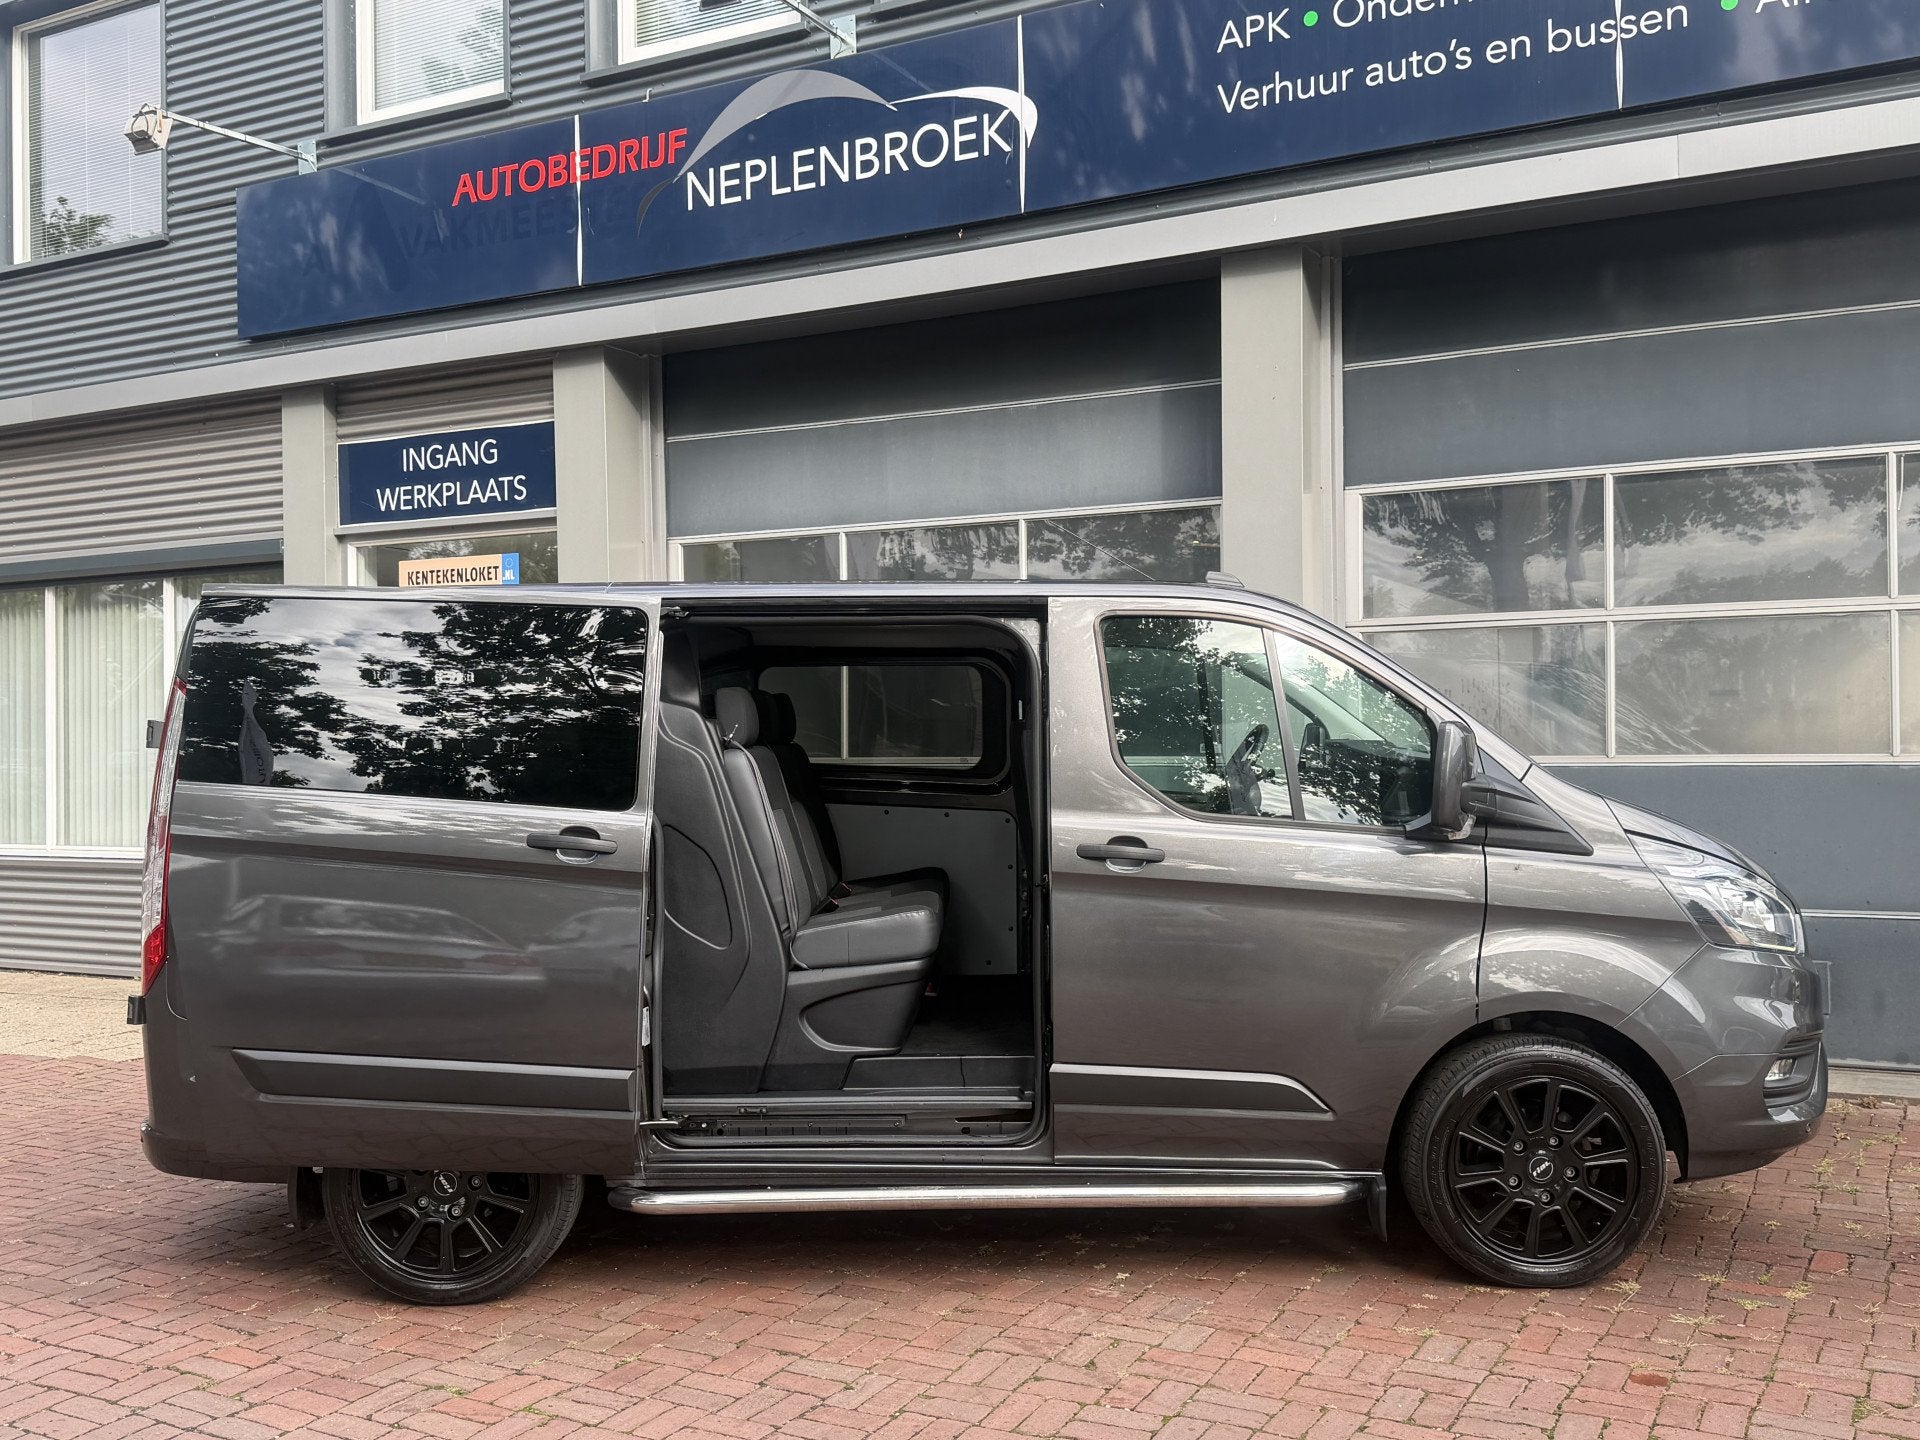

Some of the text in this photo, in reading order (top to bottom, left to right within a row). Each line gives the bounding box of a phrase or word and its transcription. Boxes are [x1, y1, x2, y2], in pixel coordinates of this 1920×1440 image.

[1217, 8, 1290, 53] APK
[1217, 4, 1688, 113] Verhuur auto’s en bussen
[452, 128, 687, 206] AUTOBEDRIJF
[686, 109, 1012, 211] NEPLENBROEK
[402, 439, 498, 472] INGANG
[376, 475, 527, 512] WERKPLAATS
[407, 566, 500, 585] KENTEKENLOKET
